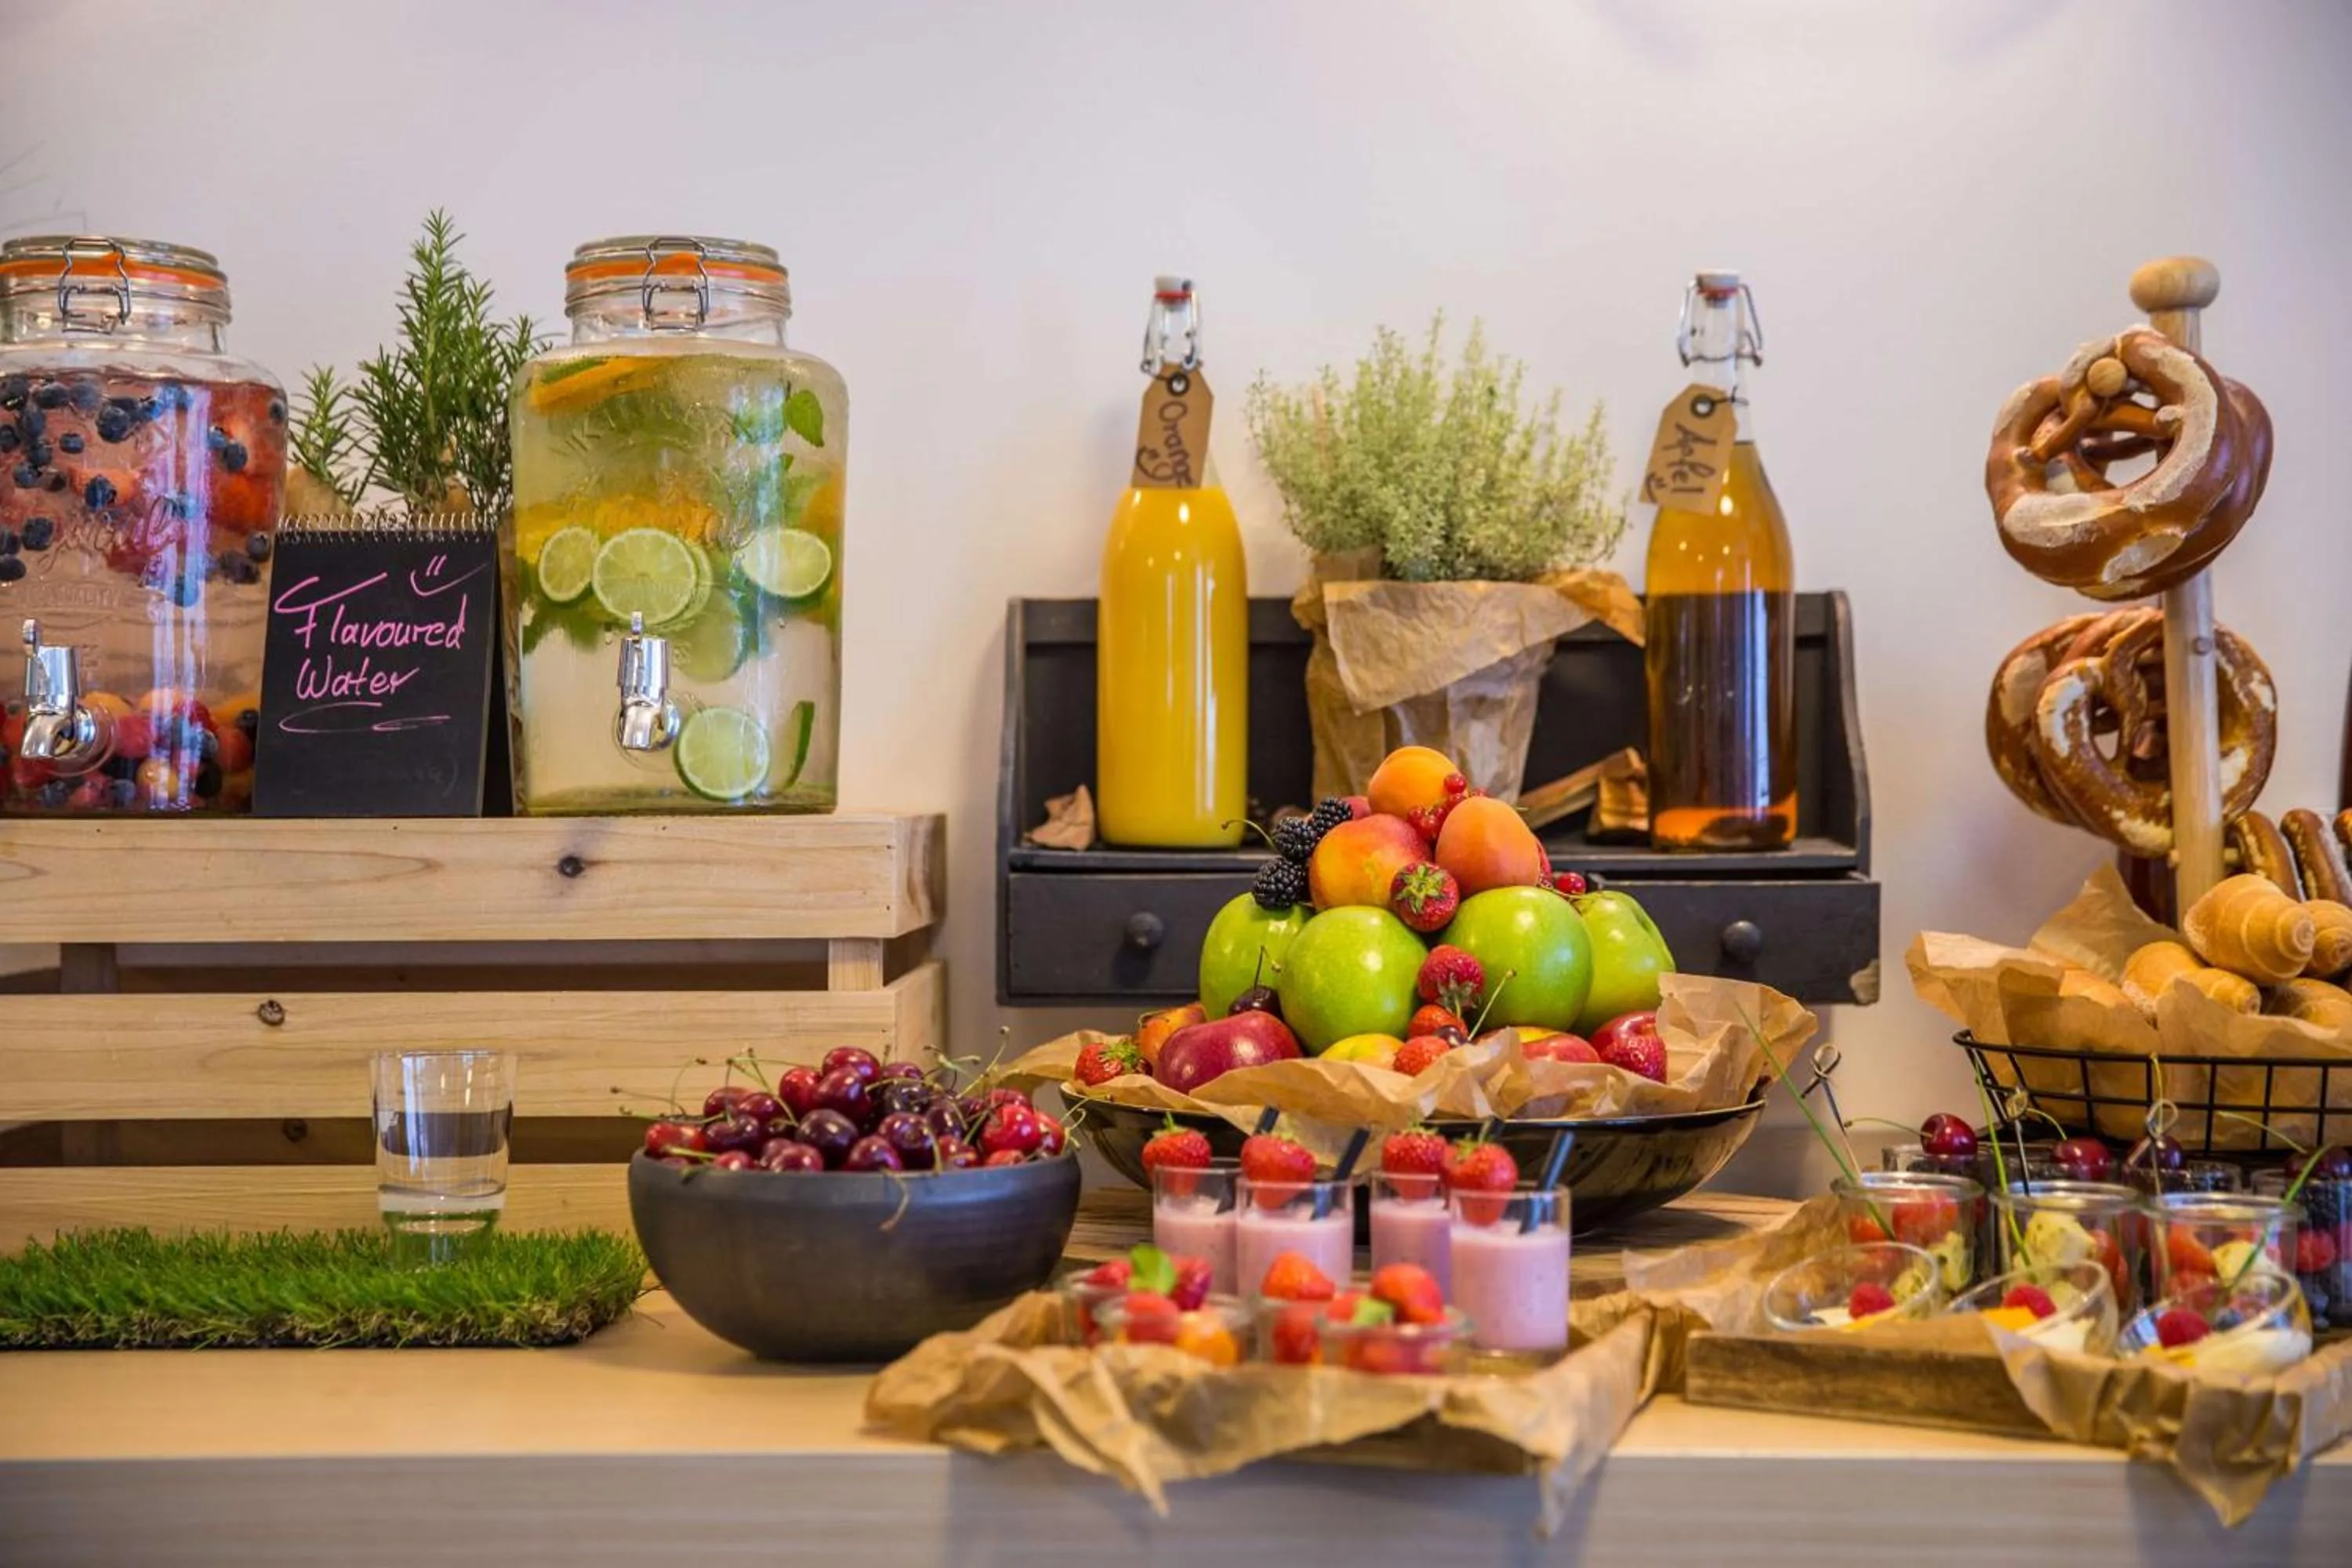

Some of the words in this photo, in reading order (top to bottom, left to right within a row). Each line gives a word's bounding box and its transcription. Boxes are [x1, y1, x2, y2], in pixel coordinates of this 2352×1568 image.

[1663, 421, 1717, 494] Apfel
[274, 572, 467, 649] Flavoured
[296, 655, 420, 700] Water
